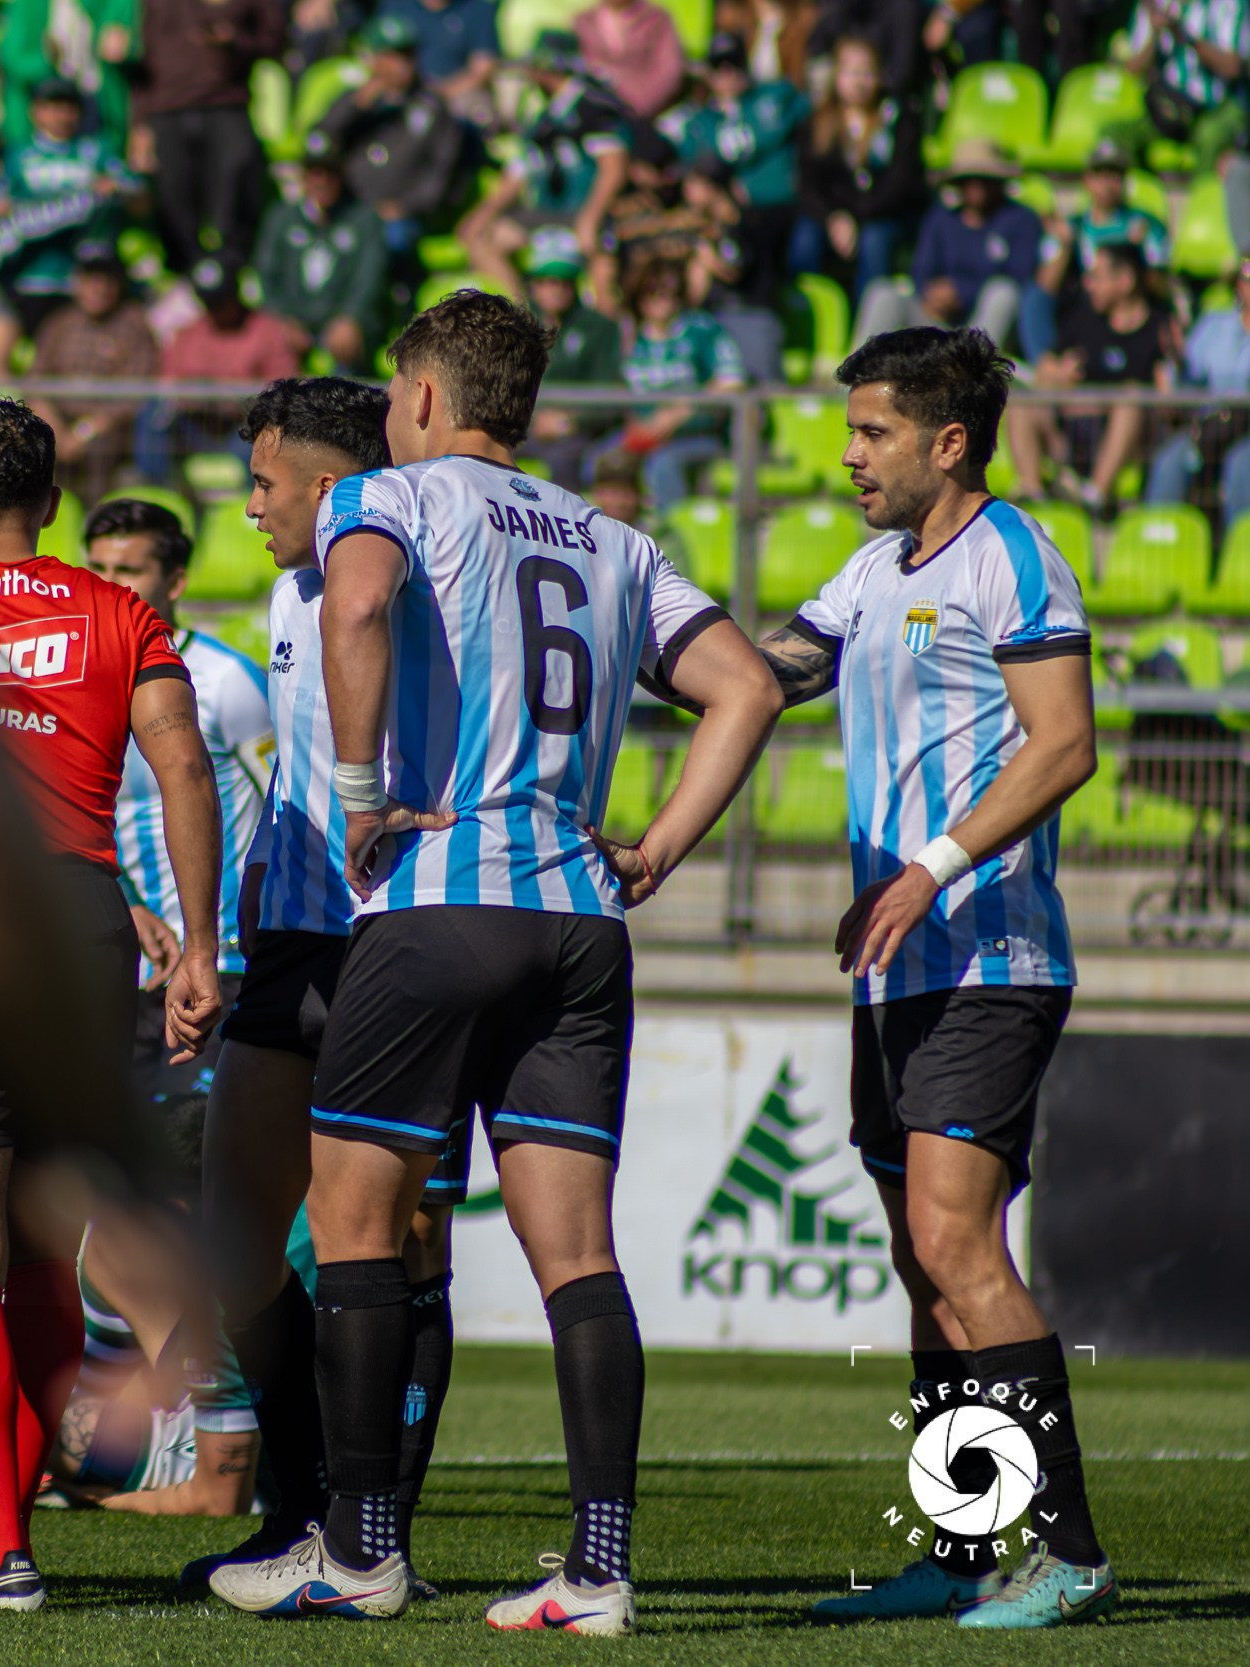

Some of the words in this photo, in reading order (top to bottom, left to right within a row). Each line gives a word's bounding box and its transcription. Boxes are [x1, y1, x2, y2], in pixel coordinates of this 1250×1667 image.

[485, 497, 598, 554] JAMES
[516, 555, 592, 735] 6
[10, 1561, 31, 1571] KING
